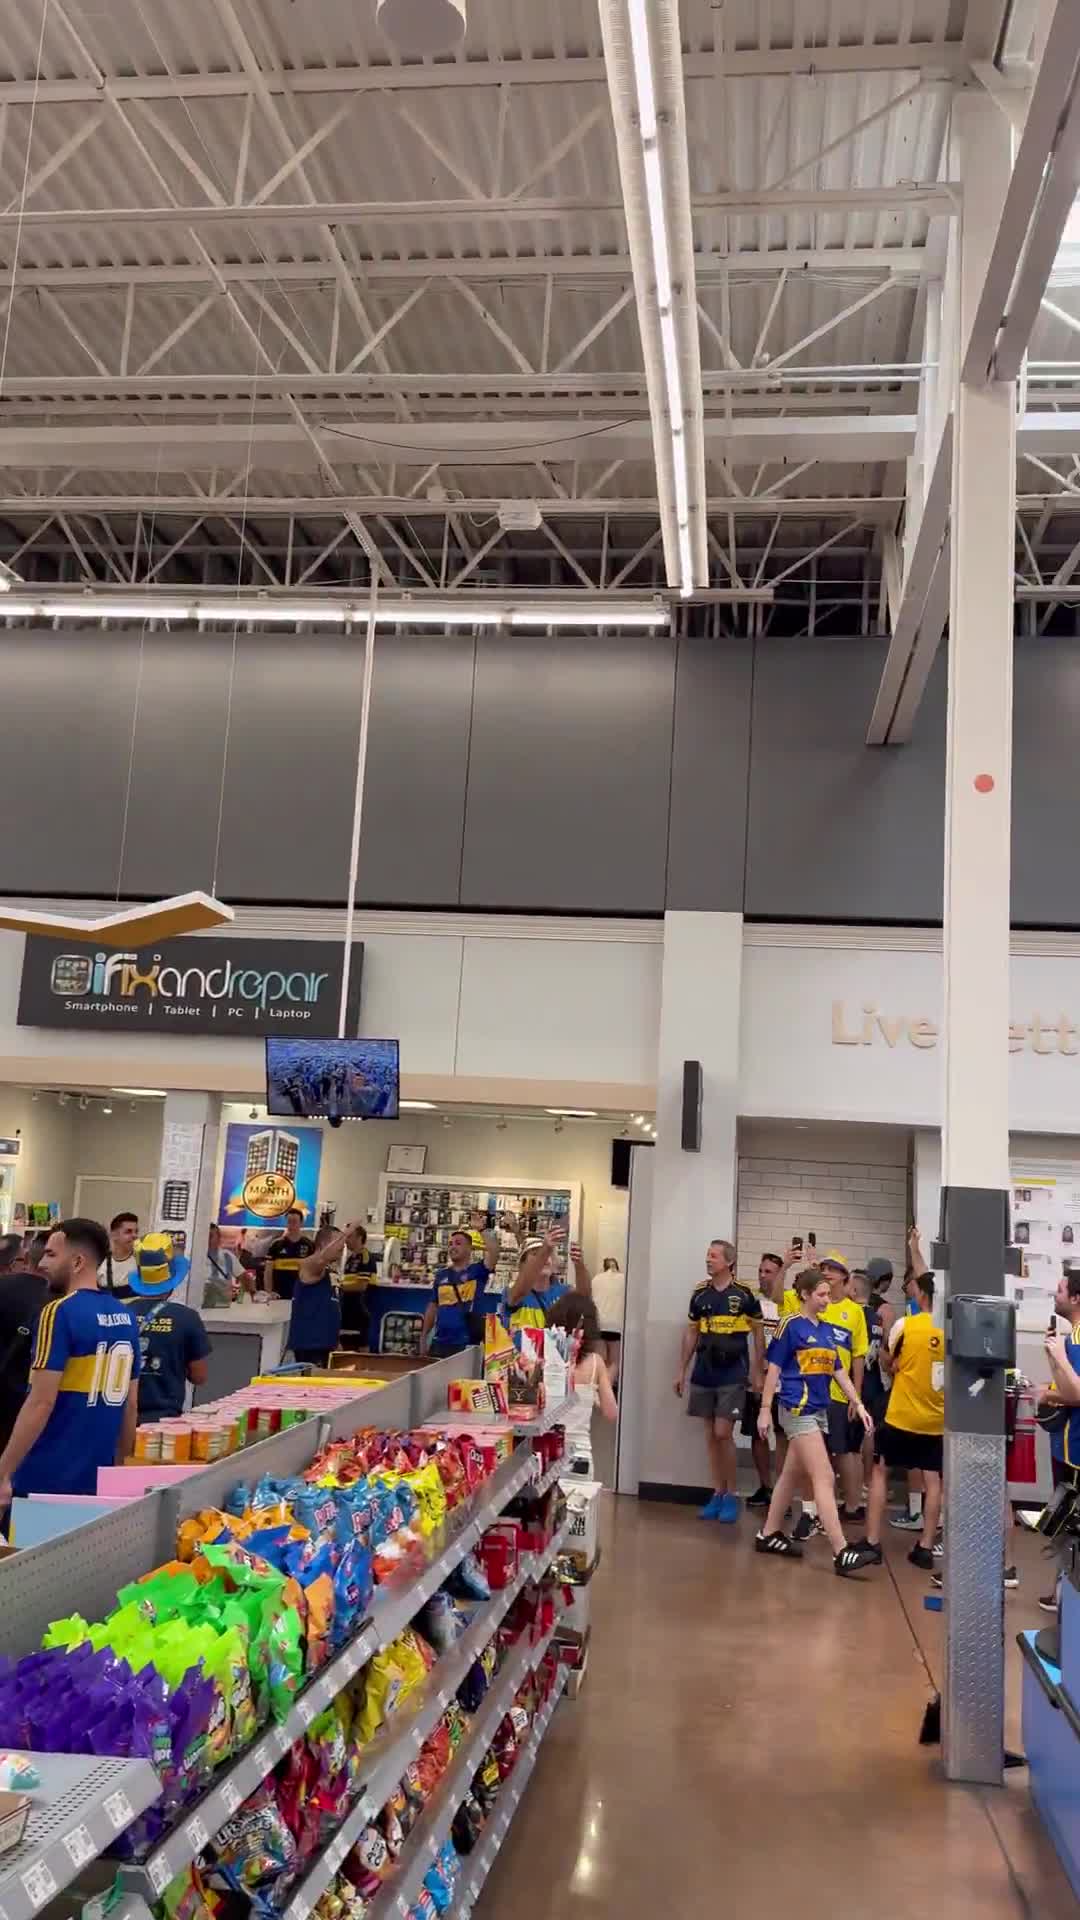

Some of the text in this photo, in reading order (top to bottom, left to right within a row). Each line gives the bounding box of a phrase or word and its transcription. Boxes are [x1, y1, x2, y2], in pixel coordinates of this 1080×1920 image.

[64, 1001, 311, 1019] Smartphone Tablet PC Laptop
[832, 1000, 938, 1048] Live
[265, 1175, 275, 1186] 6
[250, 1186, 289, 1196] MONTH
[87, 1340, 134, 1407] 10
